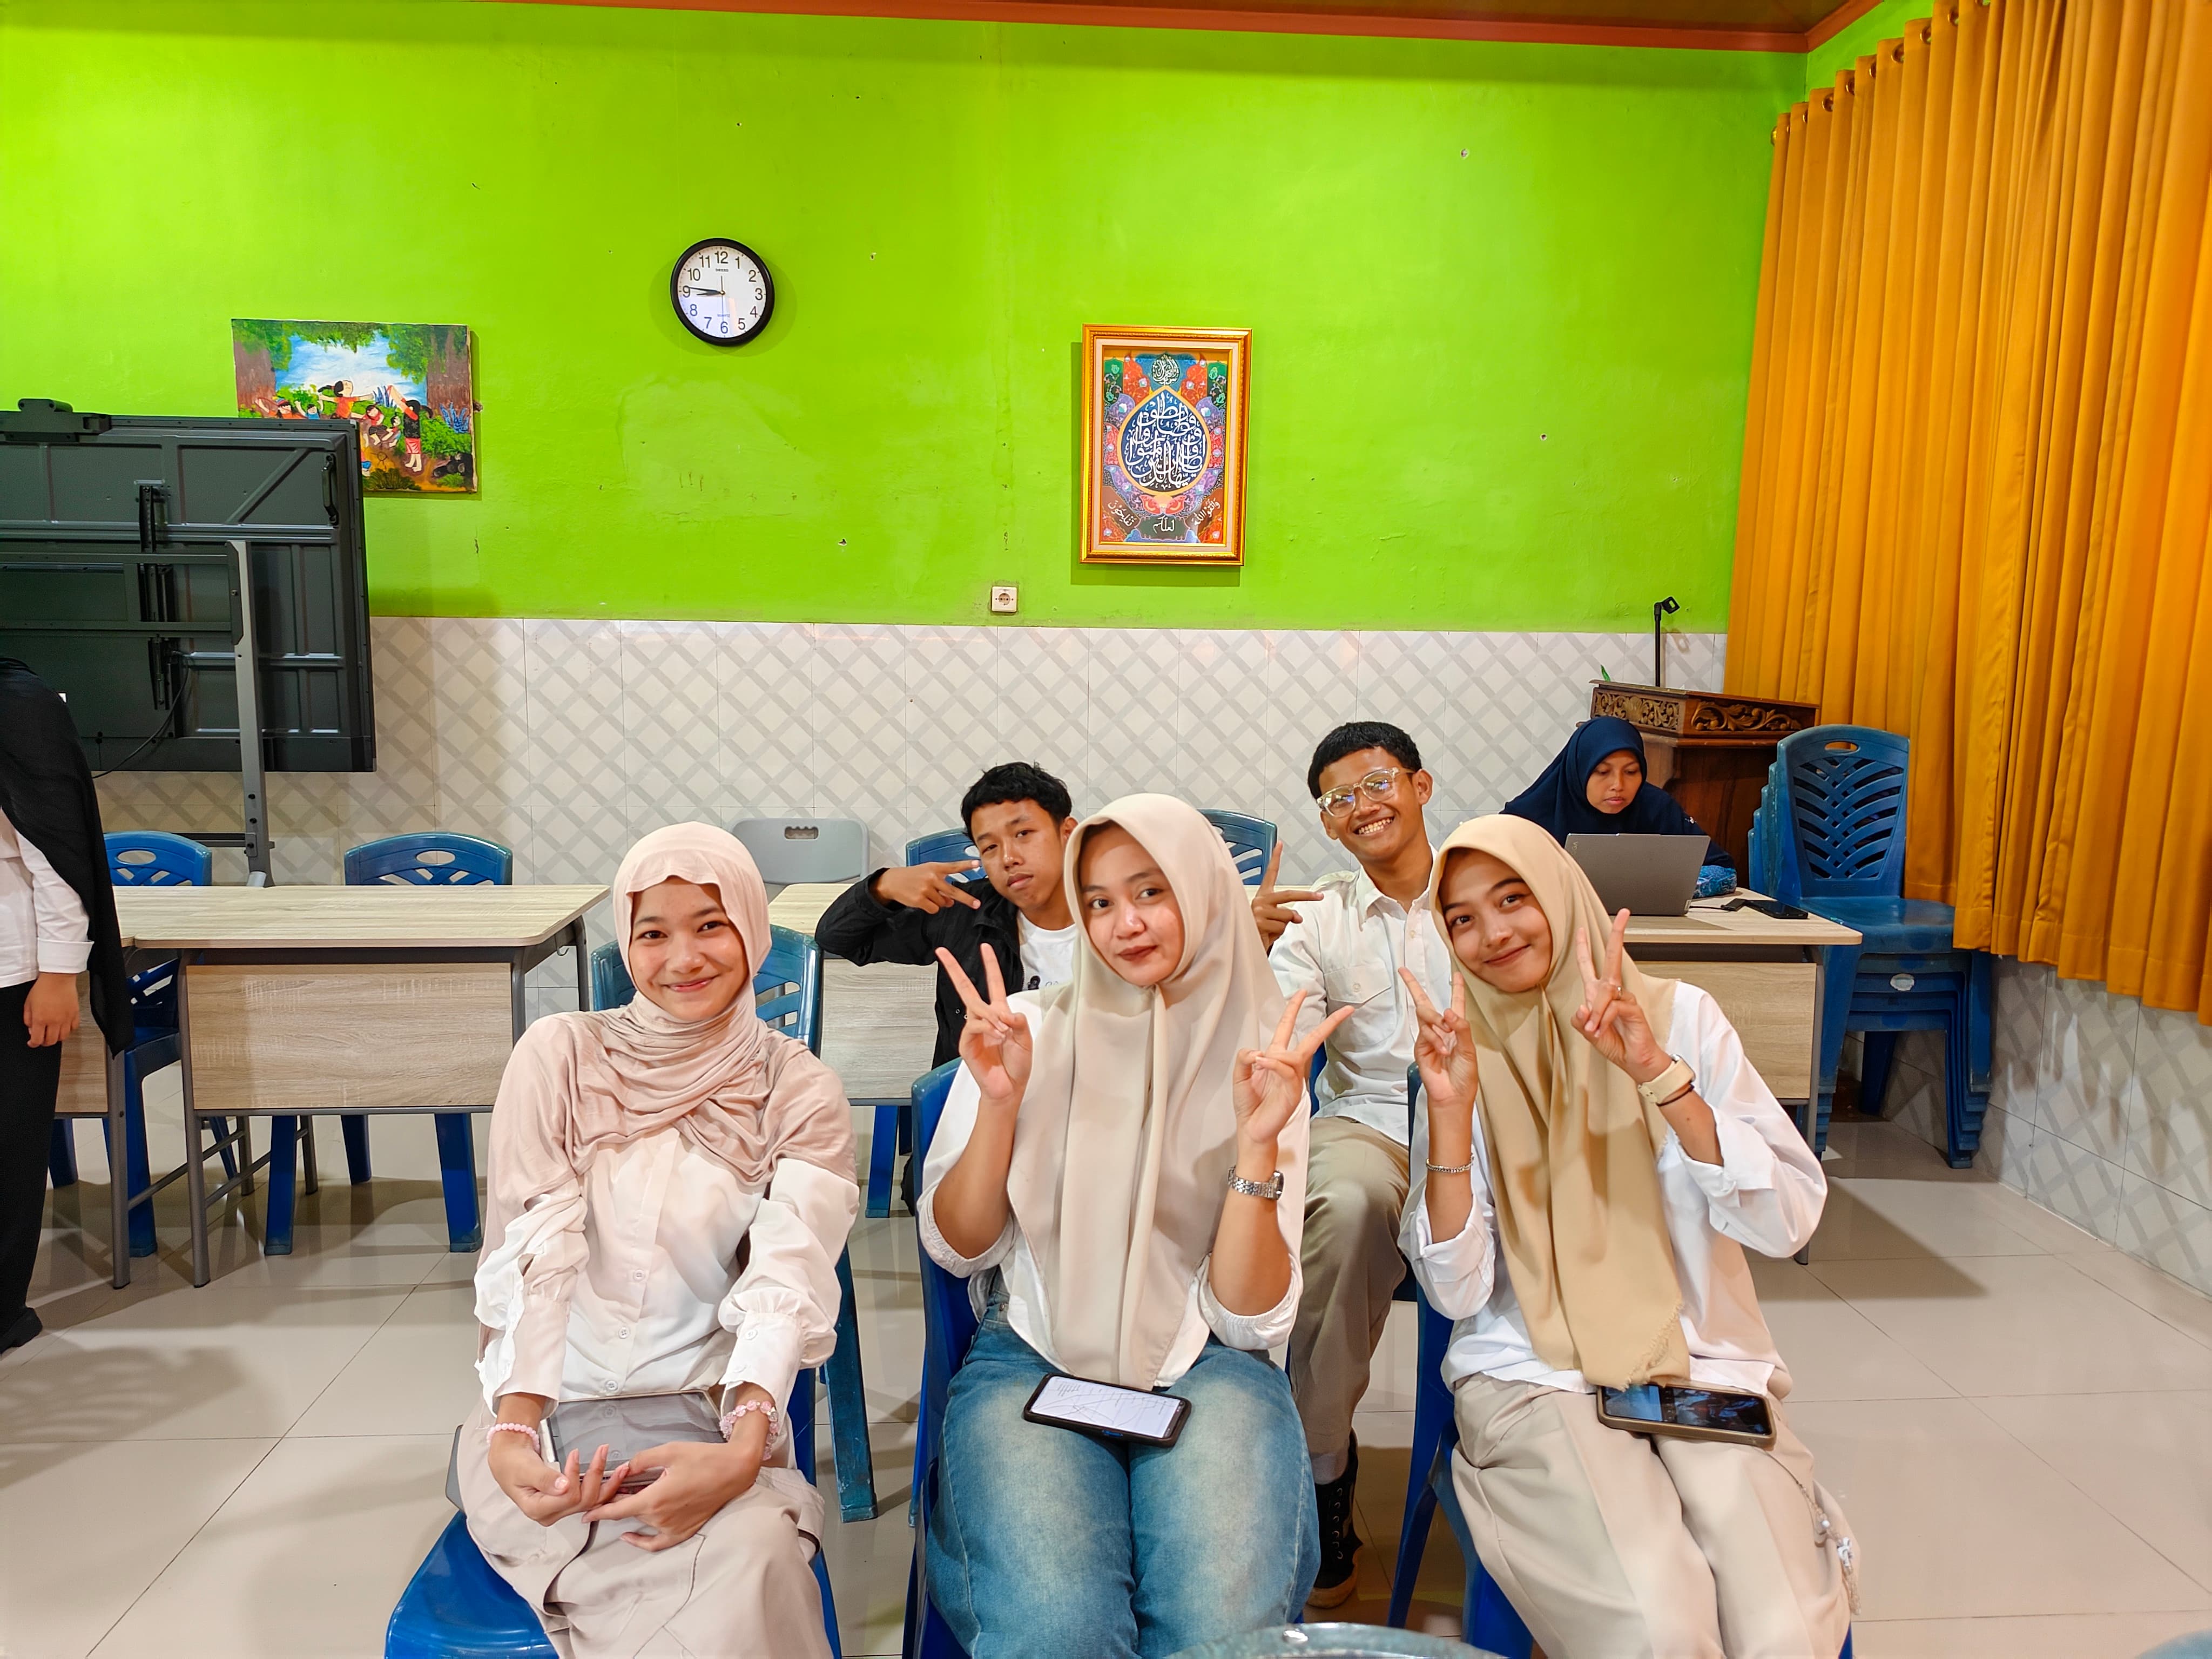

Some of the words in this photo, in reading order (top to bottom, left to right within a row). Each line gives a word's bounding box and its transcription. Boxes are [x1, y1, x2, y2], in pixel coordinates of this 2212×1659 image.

[699, 255, 711, 268] 11
[714, 251, 729, 264] 12
[735, 256, 740, 269] 1
[687, 268, 701, 281] 10
[748, 269, 757, 282] 2
[682, 285, 691, 298] 9
[754, 288, 763, 301] 3
[690, 304, 698, 316] 8
[750, 306, 758, 318] 4
[704, 316, 712, 329] 7
[720, 321, 729, 334] 6
[738, 318, 746, 330] 5
